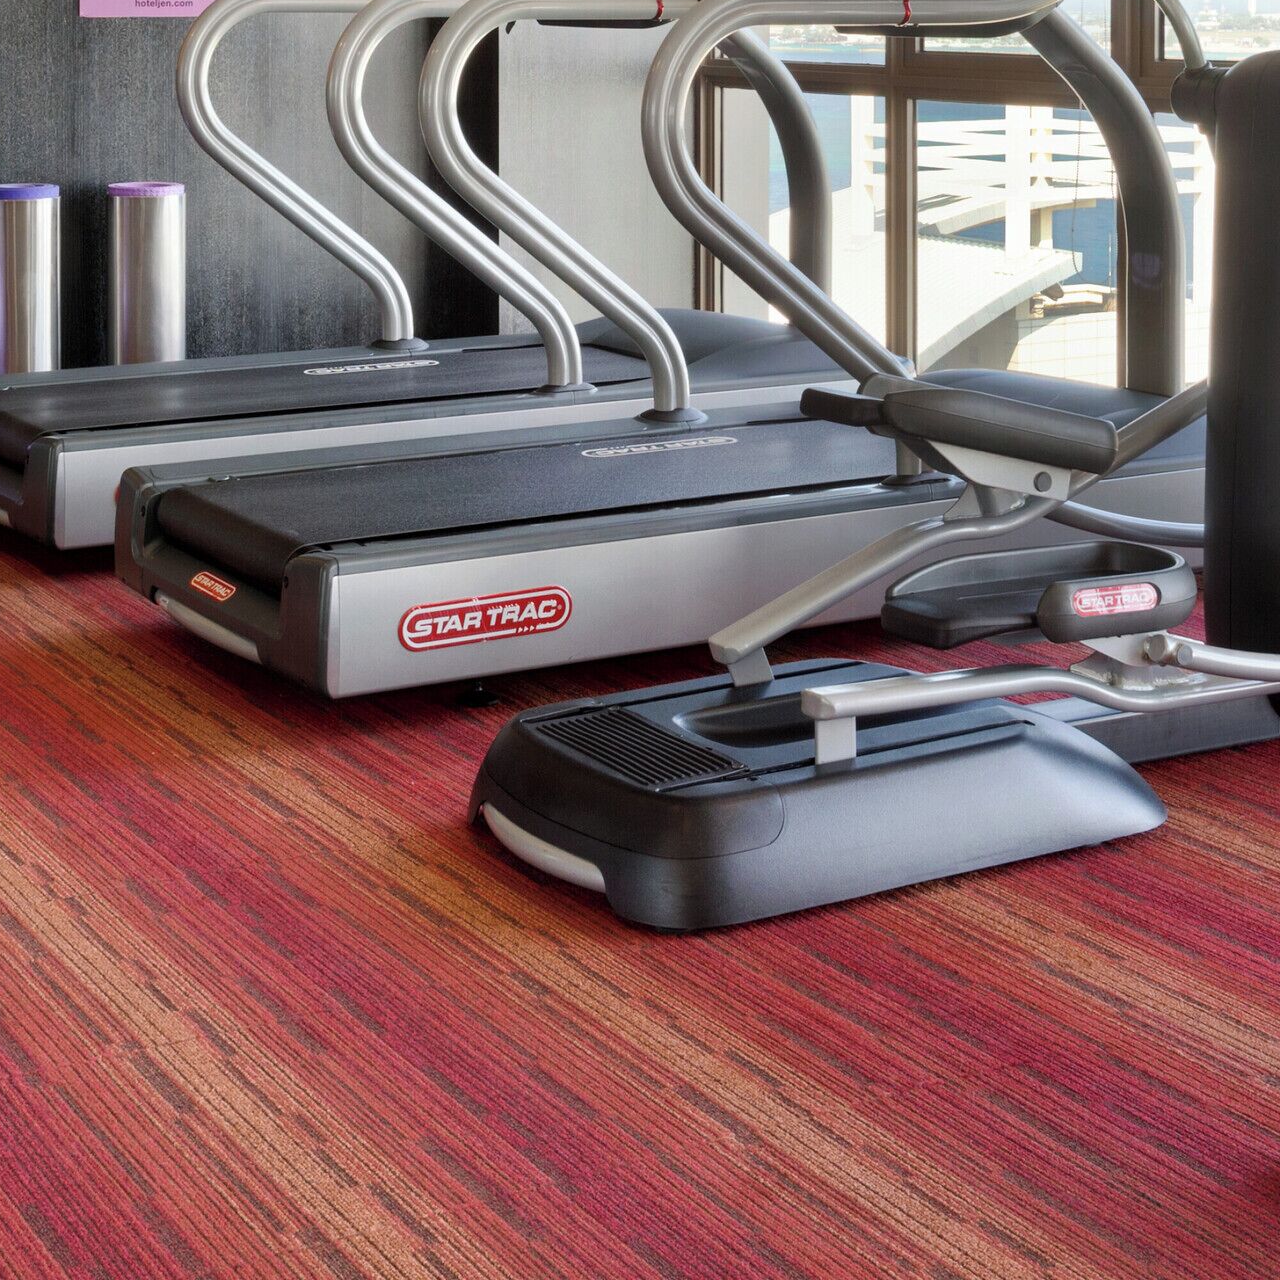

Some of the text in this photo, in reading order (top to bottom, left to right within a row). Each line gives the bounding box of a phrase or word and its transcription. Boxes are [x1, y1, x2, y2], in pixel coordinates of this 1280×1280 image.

[134, 0, 193, 9] hoteljen.com
[195, 575, 231, 597] STAR TRAC
[1081, 592, 1149, 608] STAR TRAC
[410, 600, 557, 638] STAR TRAC
